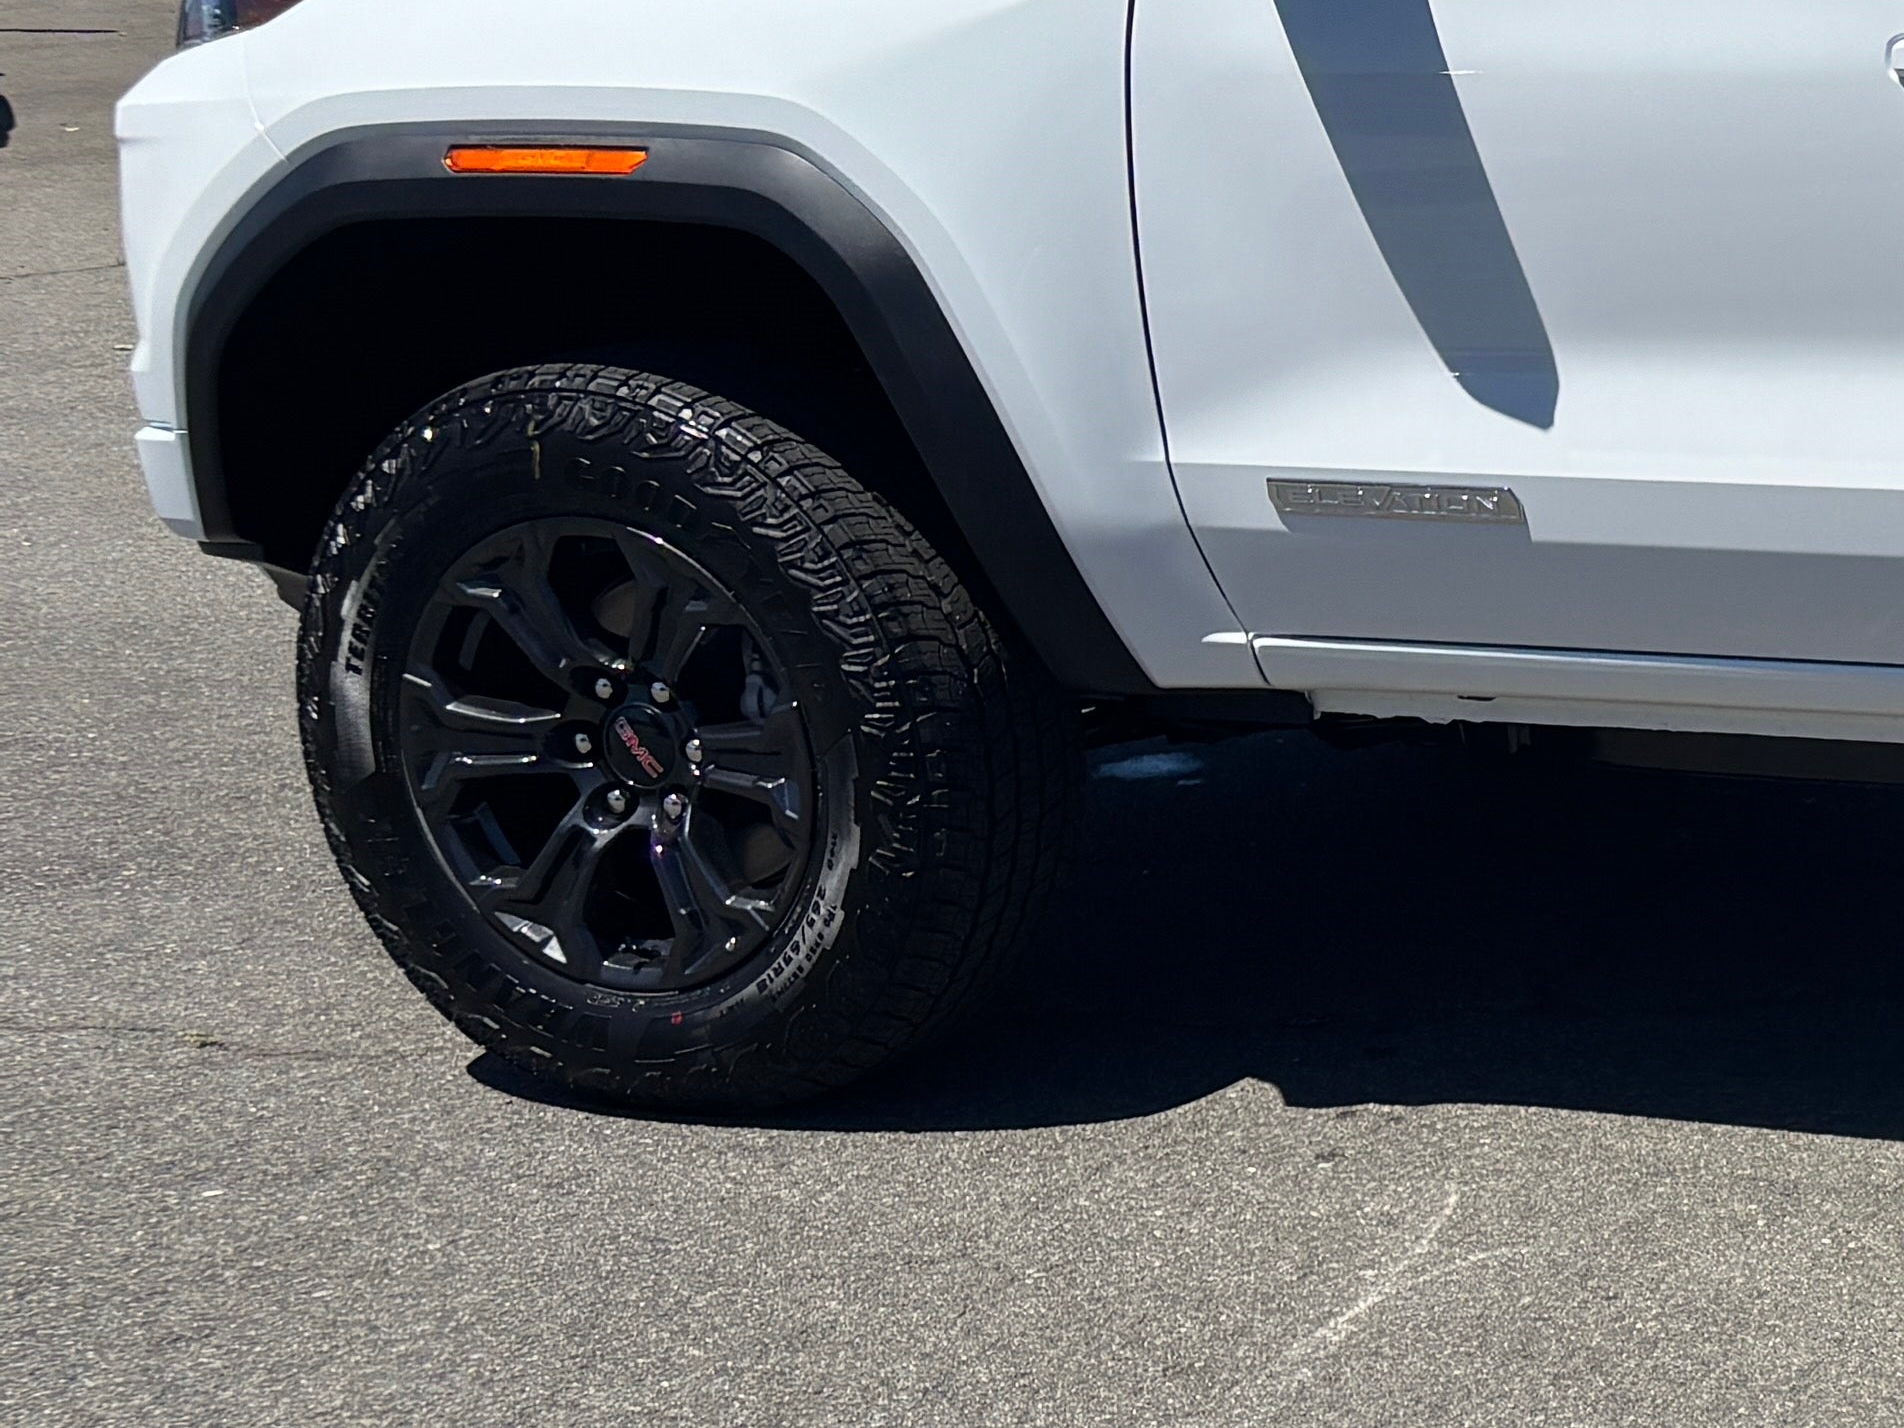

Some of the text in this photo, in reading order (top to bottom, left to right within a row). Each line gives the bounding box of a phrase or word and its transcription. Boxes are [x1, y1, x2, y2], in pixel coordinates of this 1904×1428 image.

[1287, 483, 1499, 513] ELEVATION
[613, 715, 665, 780] GMC
[755, 886, 828, 995] 265/65R18
